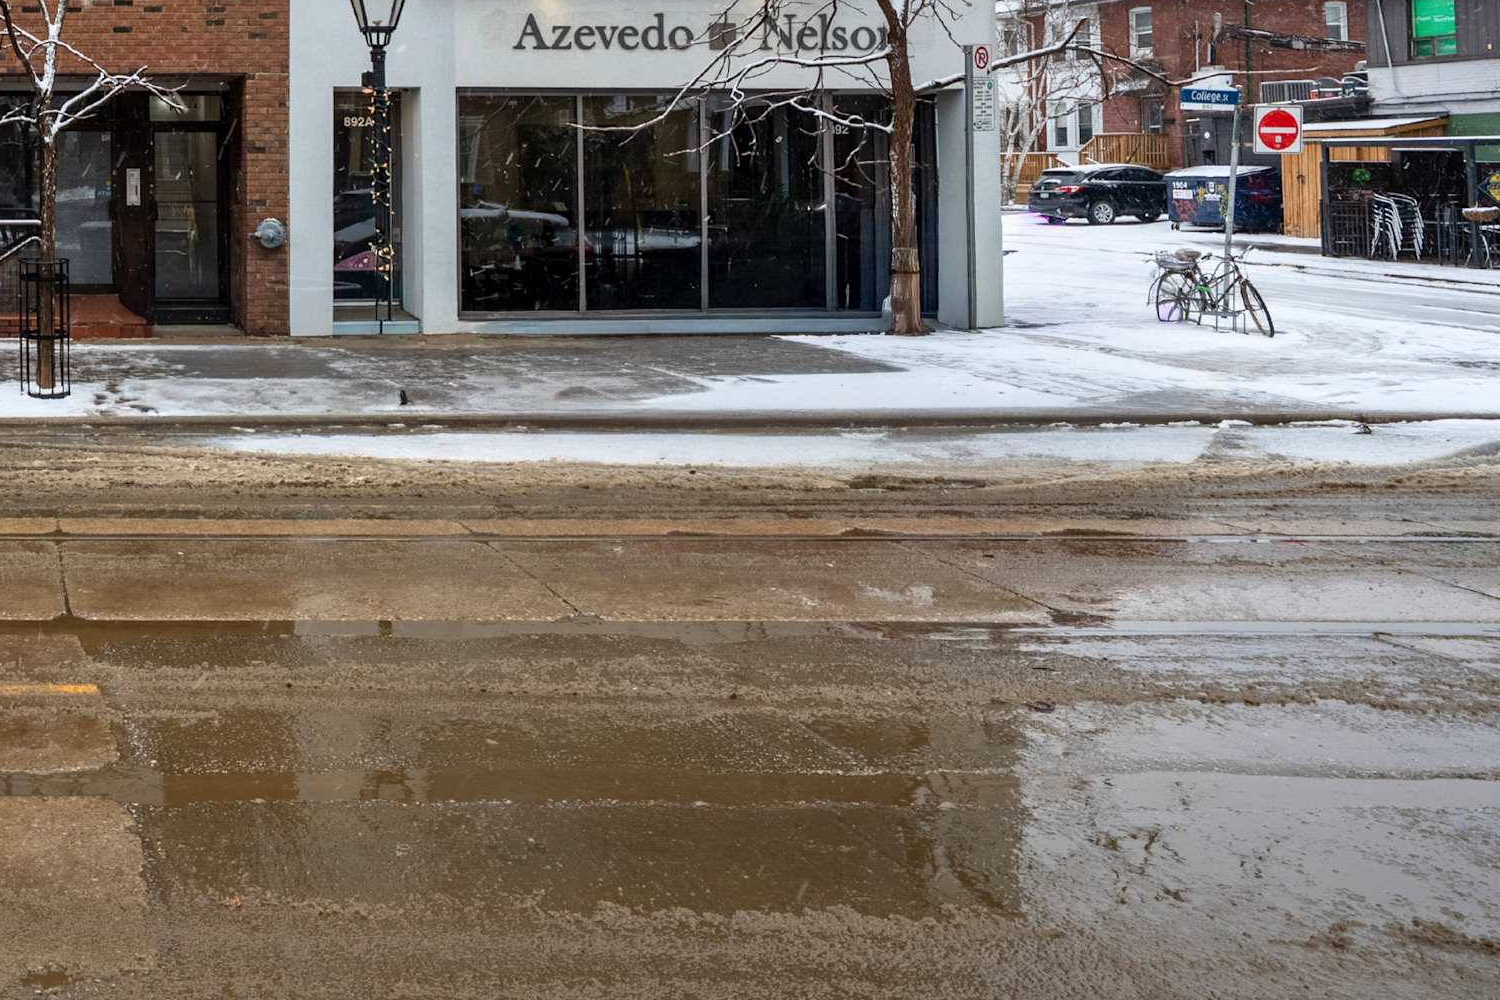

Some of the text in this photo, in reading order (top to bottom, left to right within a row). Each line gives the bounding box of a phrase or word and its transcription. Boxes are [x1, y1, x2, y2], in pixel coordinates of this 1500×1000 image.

[513, 13, 694, 51] Azevedo
[1191, 90, 1221, 102] College
[343, 116, 374, 127] 892A
[833, 124, 850, 135] 92
